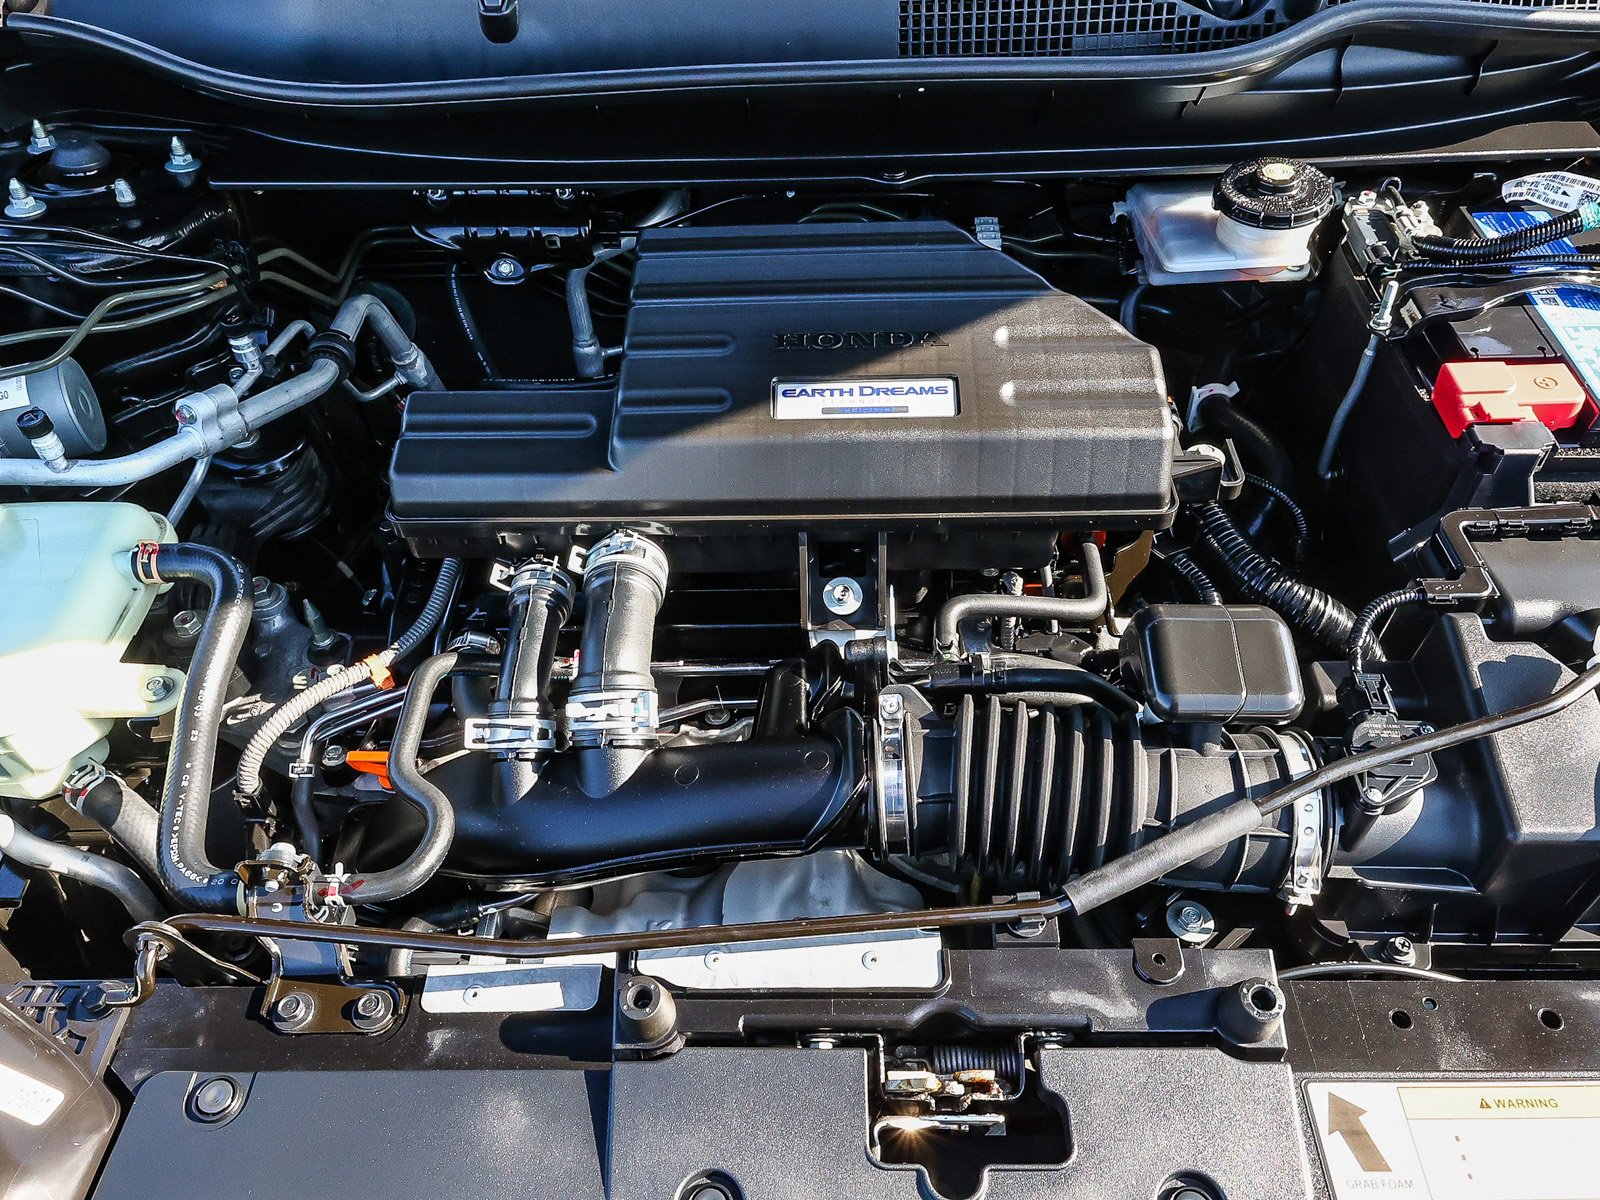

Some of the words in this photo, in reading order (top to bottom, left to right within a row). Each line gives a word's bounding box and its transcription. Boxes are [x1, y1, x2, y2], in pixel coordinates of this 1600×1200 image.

[772, 330, 951, 350] HONDA
[781, 386, 854, 398] EARTH
[859, 385, 949, 397] DREAMS
[234, 578, 245, 606] Y-TEC
[181, 774, 190, 787] C2
[173, 792, 187, 824] Y-TEC
[1493, 1098, 1559, 1109] WARNING
[1345, 1179, 1379, 1189] GRAB
[1381, 1178, 1414, 1189] FOAM
